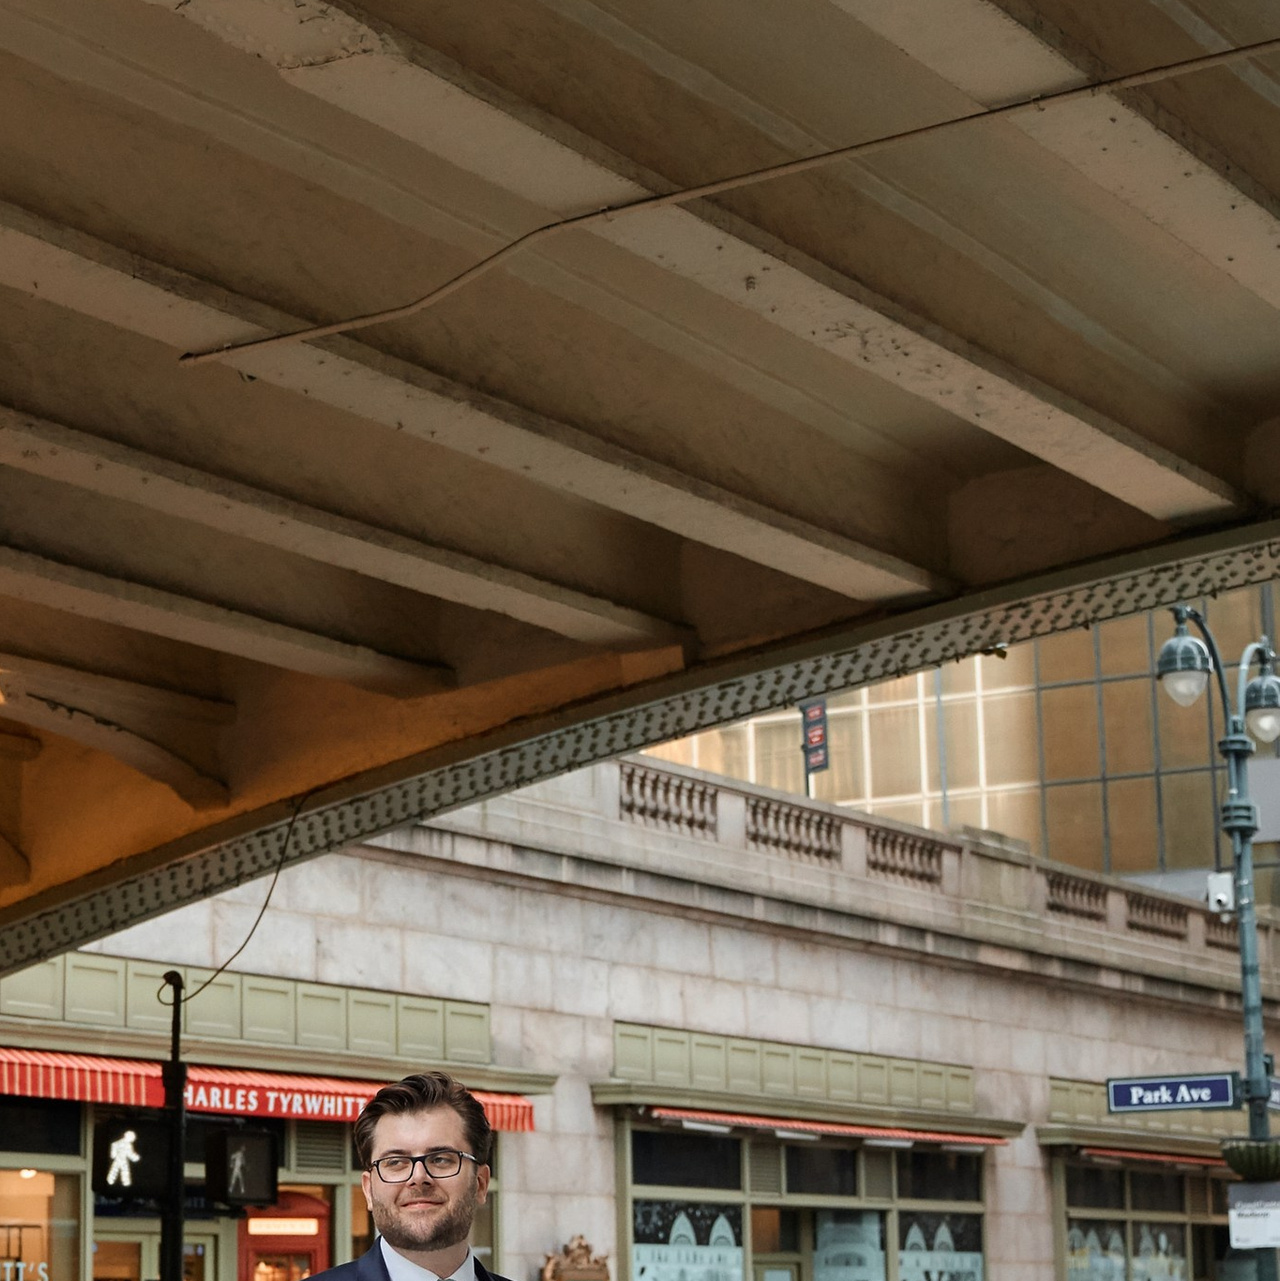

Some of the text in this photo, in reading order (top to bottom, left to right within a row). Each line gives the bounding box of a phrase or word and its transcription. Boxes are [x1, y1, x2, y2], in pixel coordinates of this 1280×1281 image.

[183, 1084, 368, 1118] HARLES TYRWHITT
[1130, 1084, 1212, 1105] Park Ave
